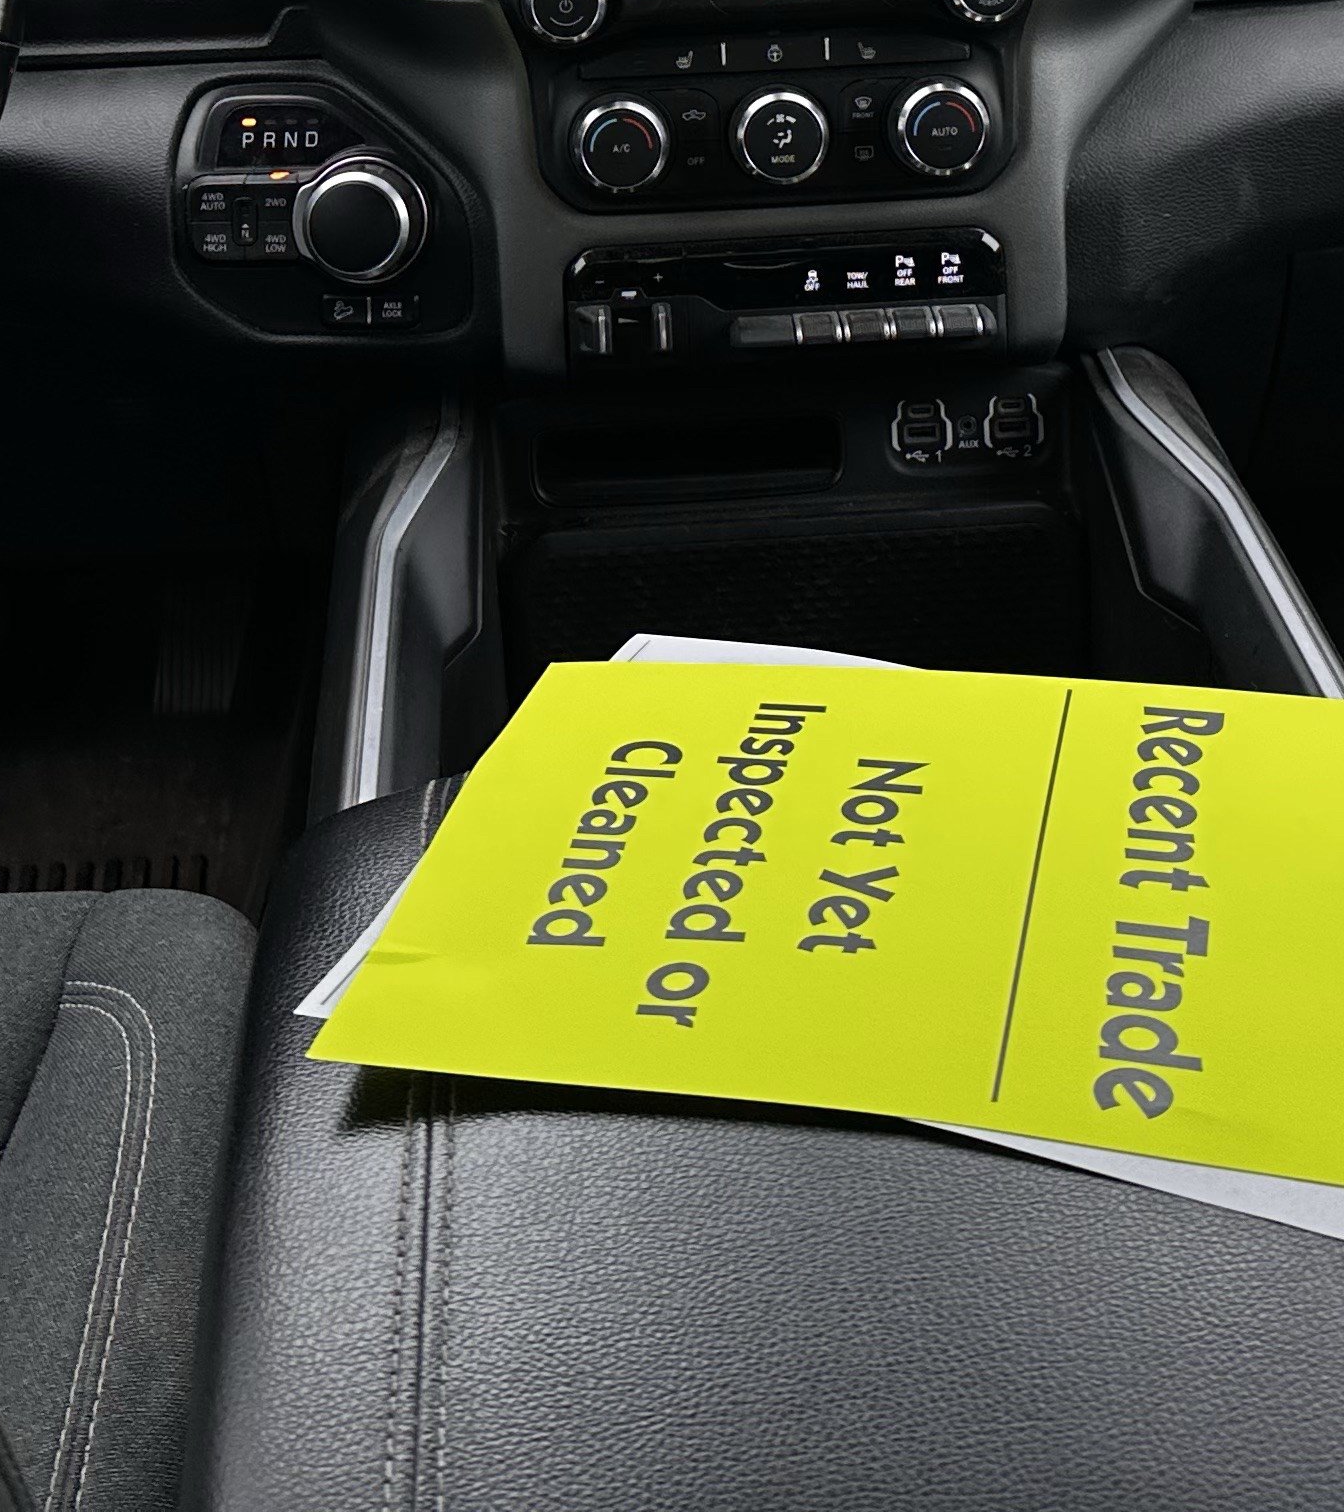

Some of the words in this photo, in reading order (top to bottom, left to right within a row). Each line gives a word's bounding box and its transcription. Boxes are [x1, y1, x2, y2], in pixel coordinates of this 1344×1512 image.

[931, 126, 959, 137] AUTO
[242, 131, 255, 149] P
[263, 131, 276, 148] R
[284, 131, 298, 148] N
[306, 131, 319, 148] D
[612, 143, 631, 154] A/C
[687, 156, 706, 166] OFF
[771, 154, 796, 165] MODE
[201, 192, 224, 202] 4WD
[200, 200, 226, 211] AUTO
[265, 197, 287, 208] 2WD
[205, 234, 227, 243] 4WD
[265, 234, 287, 244] 4WD
[203, 243, 227, 253] HIGH
[265, 243, 287, 253] LOW
[897, 268, 913, 277] OFF
[943, 266, 959, 275] OFF
[895, 277, 916, 287] REAR
[938, 274, 965, 284] FRONT
[804, 282, 821, 291] OFF
[847, 280, 869, 290] HAUL
[382, 309, 403, 318] LOCK
[958, 439, 979, 449] AUX
[830, 759, 929, 848] Not
[1120, 707, 1225, 891] Recent
[665, 703, 826, 942] Inspected
[526, 741, 684, 946] Cleaned
[797, 866, 899, 954] Yet
[636, 962, 709, 1029] or
[1094, 916, 1209, 1120] Trade
